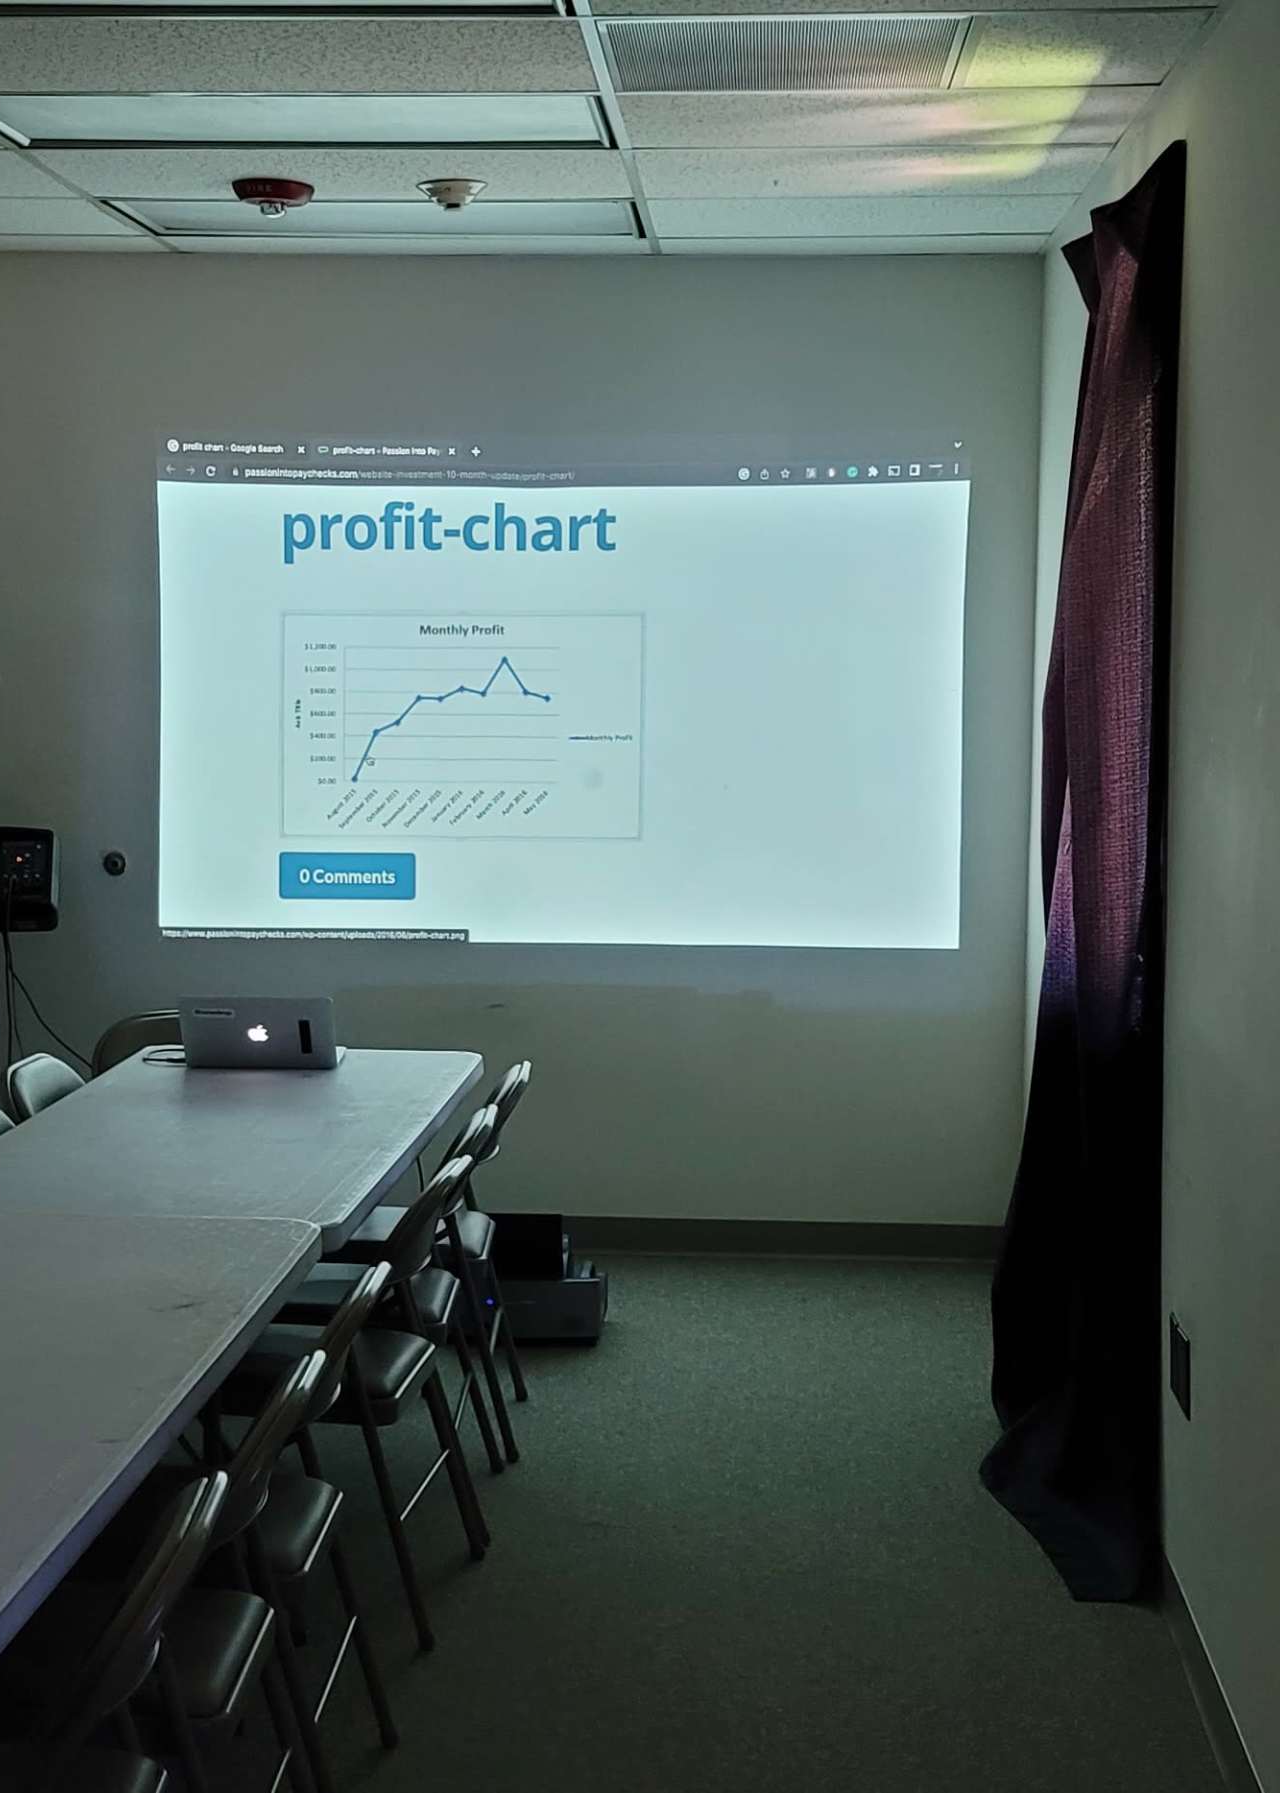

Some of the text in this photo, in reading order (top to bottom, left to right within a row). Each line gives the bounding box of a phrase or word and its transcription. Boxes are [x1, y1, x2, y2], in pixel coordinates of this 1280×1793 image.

[182, 442, 203, 452] profit
[230, 443, 257, 454] Google
[258, 445, 285, 454] Search
[332, 446, 376, 456] profit-chart
[382, 446, 410, 456] Passion
[283, 501, 617, 564] profit-chart
[419, 624, 505, 637] Monthly Profit
[299, 868, 396, 884] 0 Comments
